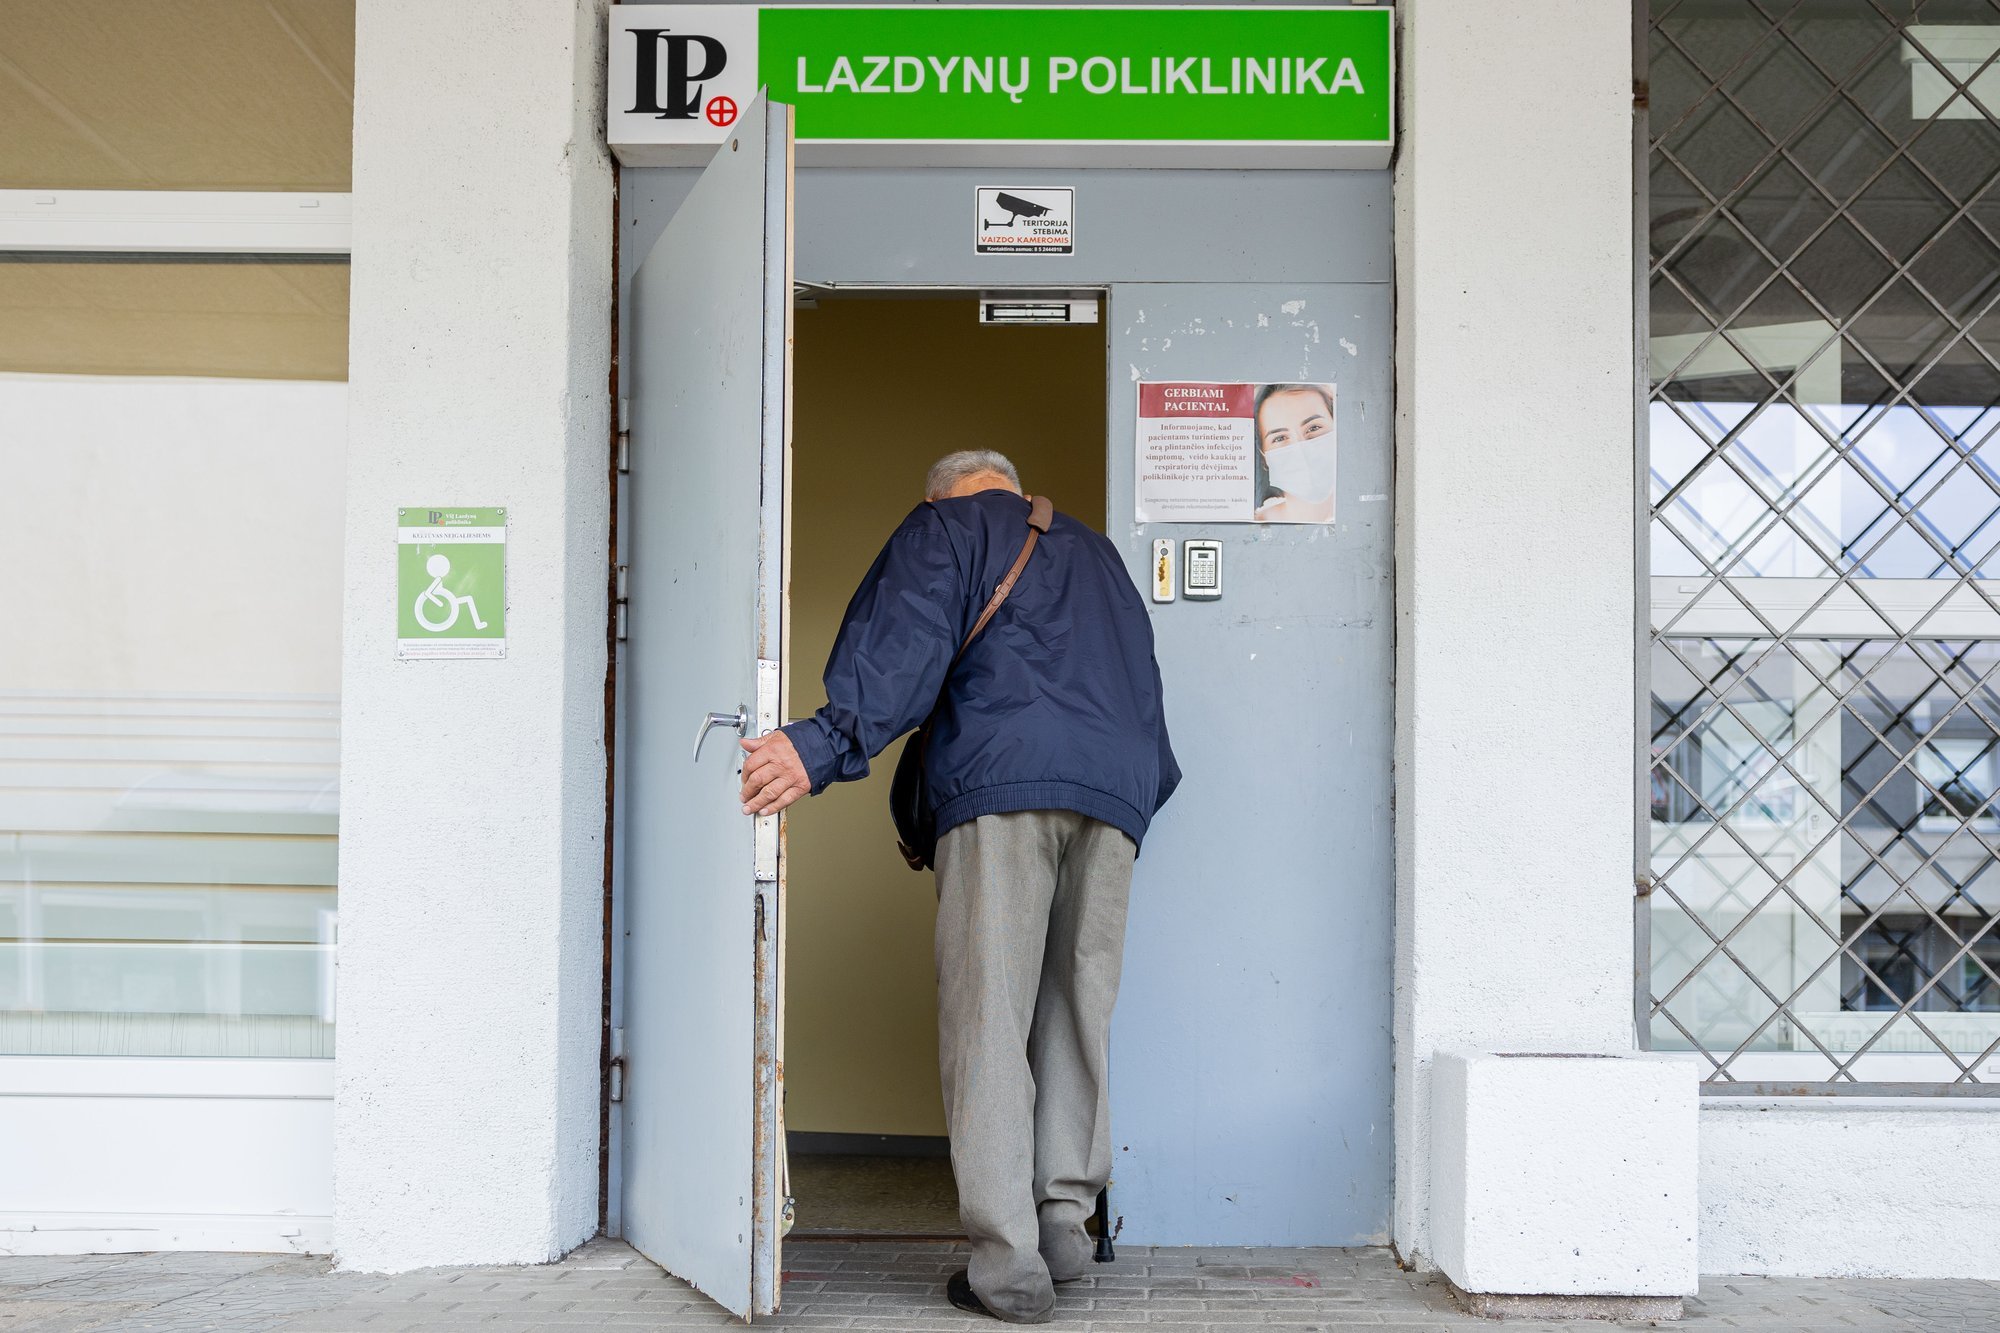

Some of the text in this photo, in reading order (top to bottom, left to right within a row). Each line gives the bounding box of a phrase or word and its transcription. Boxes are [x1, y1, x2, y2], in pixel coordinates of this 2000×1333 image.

[797, 56, 1365, 103] LAZDYNŲ POLIKLINIKA
[1164, 388, 1224, 398] GERBIAMI
[1164, 401, 1230, 413] PACIENTAI,
[1160, 424, 1216, 432] Informuojame,
[1148, 434, 1190, 442] pacientams
[1164, 443, 1205, 452] plintančios
[1206, 443, 1243, 452] infekcijos
[1145, 454, 1185, 462] simptomų,
[1210, 454, 1237, 462] kaukių
[1154, 464, 1238, 472] respiratorių dėvėjimas
[1142, 474, 1250, 482] poliklinikoje yra privalomas.
